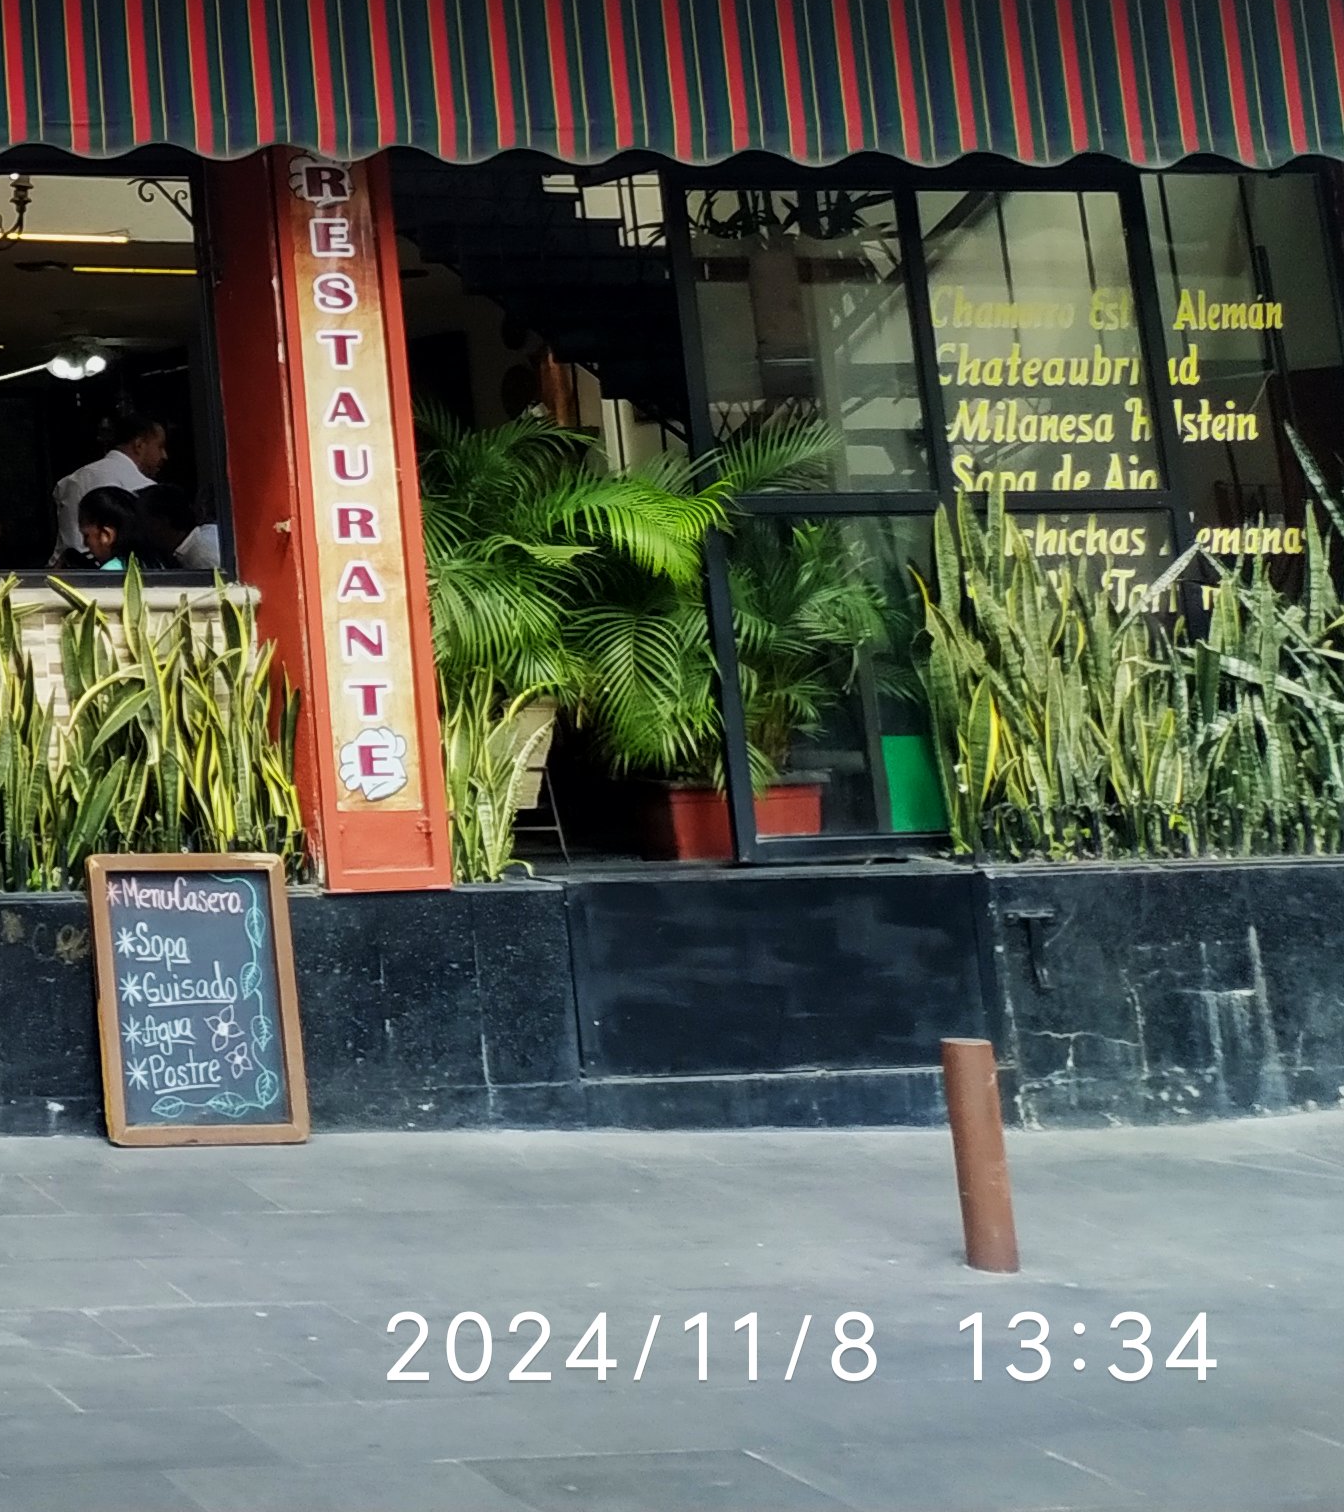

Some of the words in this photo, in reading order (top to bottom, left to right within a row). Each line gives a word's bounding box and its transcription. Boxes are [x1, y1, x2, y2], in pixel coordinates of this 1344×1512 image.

[1173, 289, 1284, 331] Alemán
[946, 397, 1115, 443] Milanesa
[307, 164, 393, 778] RESTAURANTE
[142, 960, 238, 1004] Guisado
[150, 1049, 222, 1089] Postre
